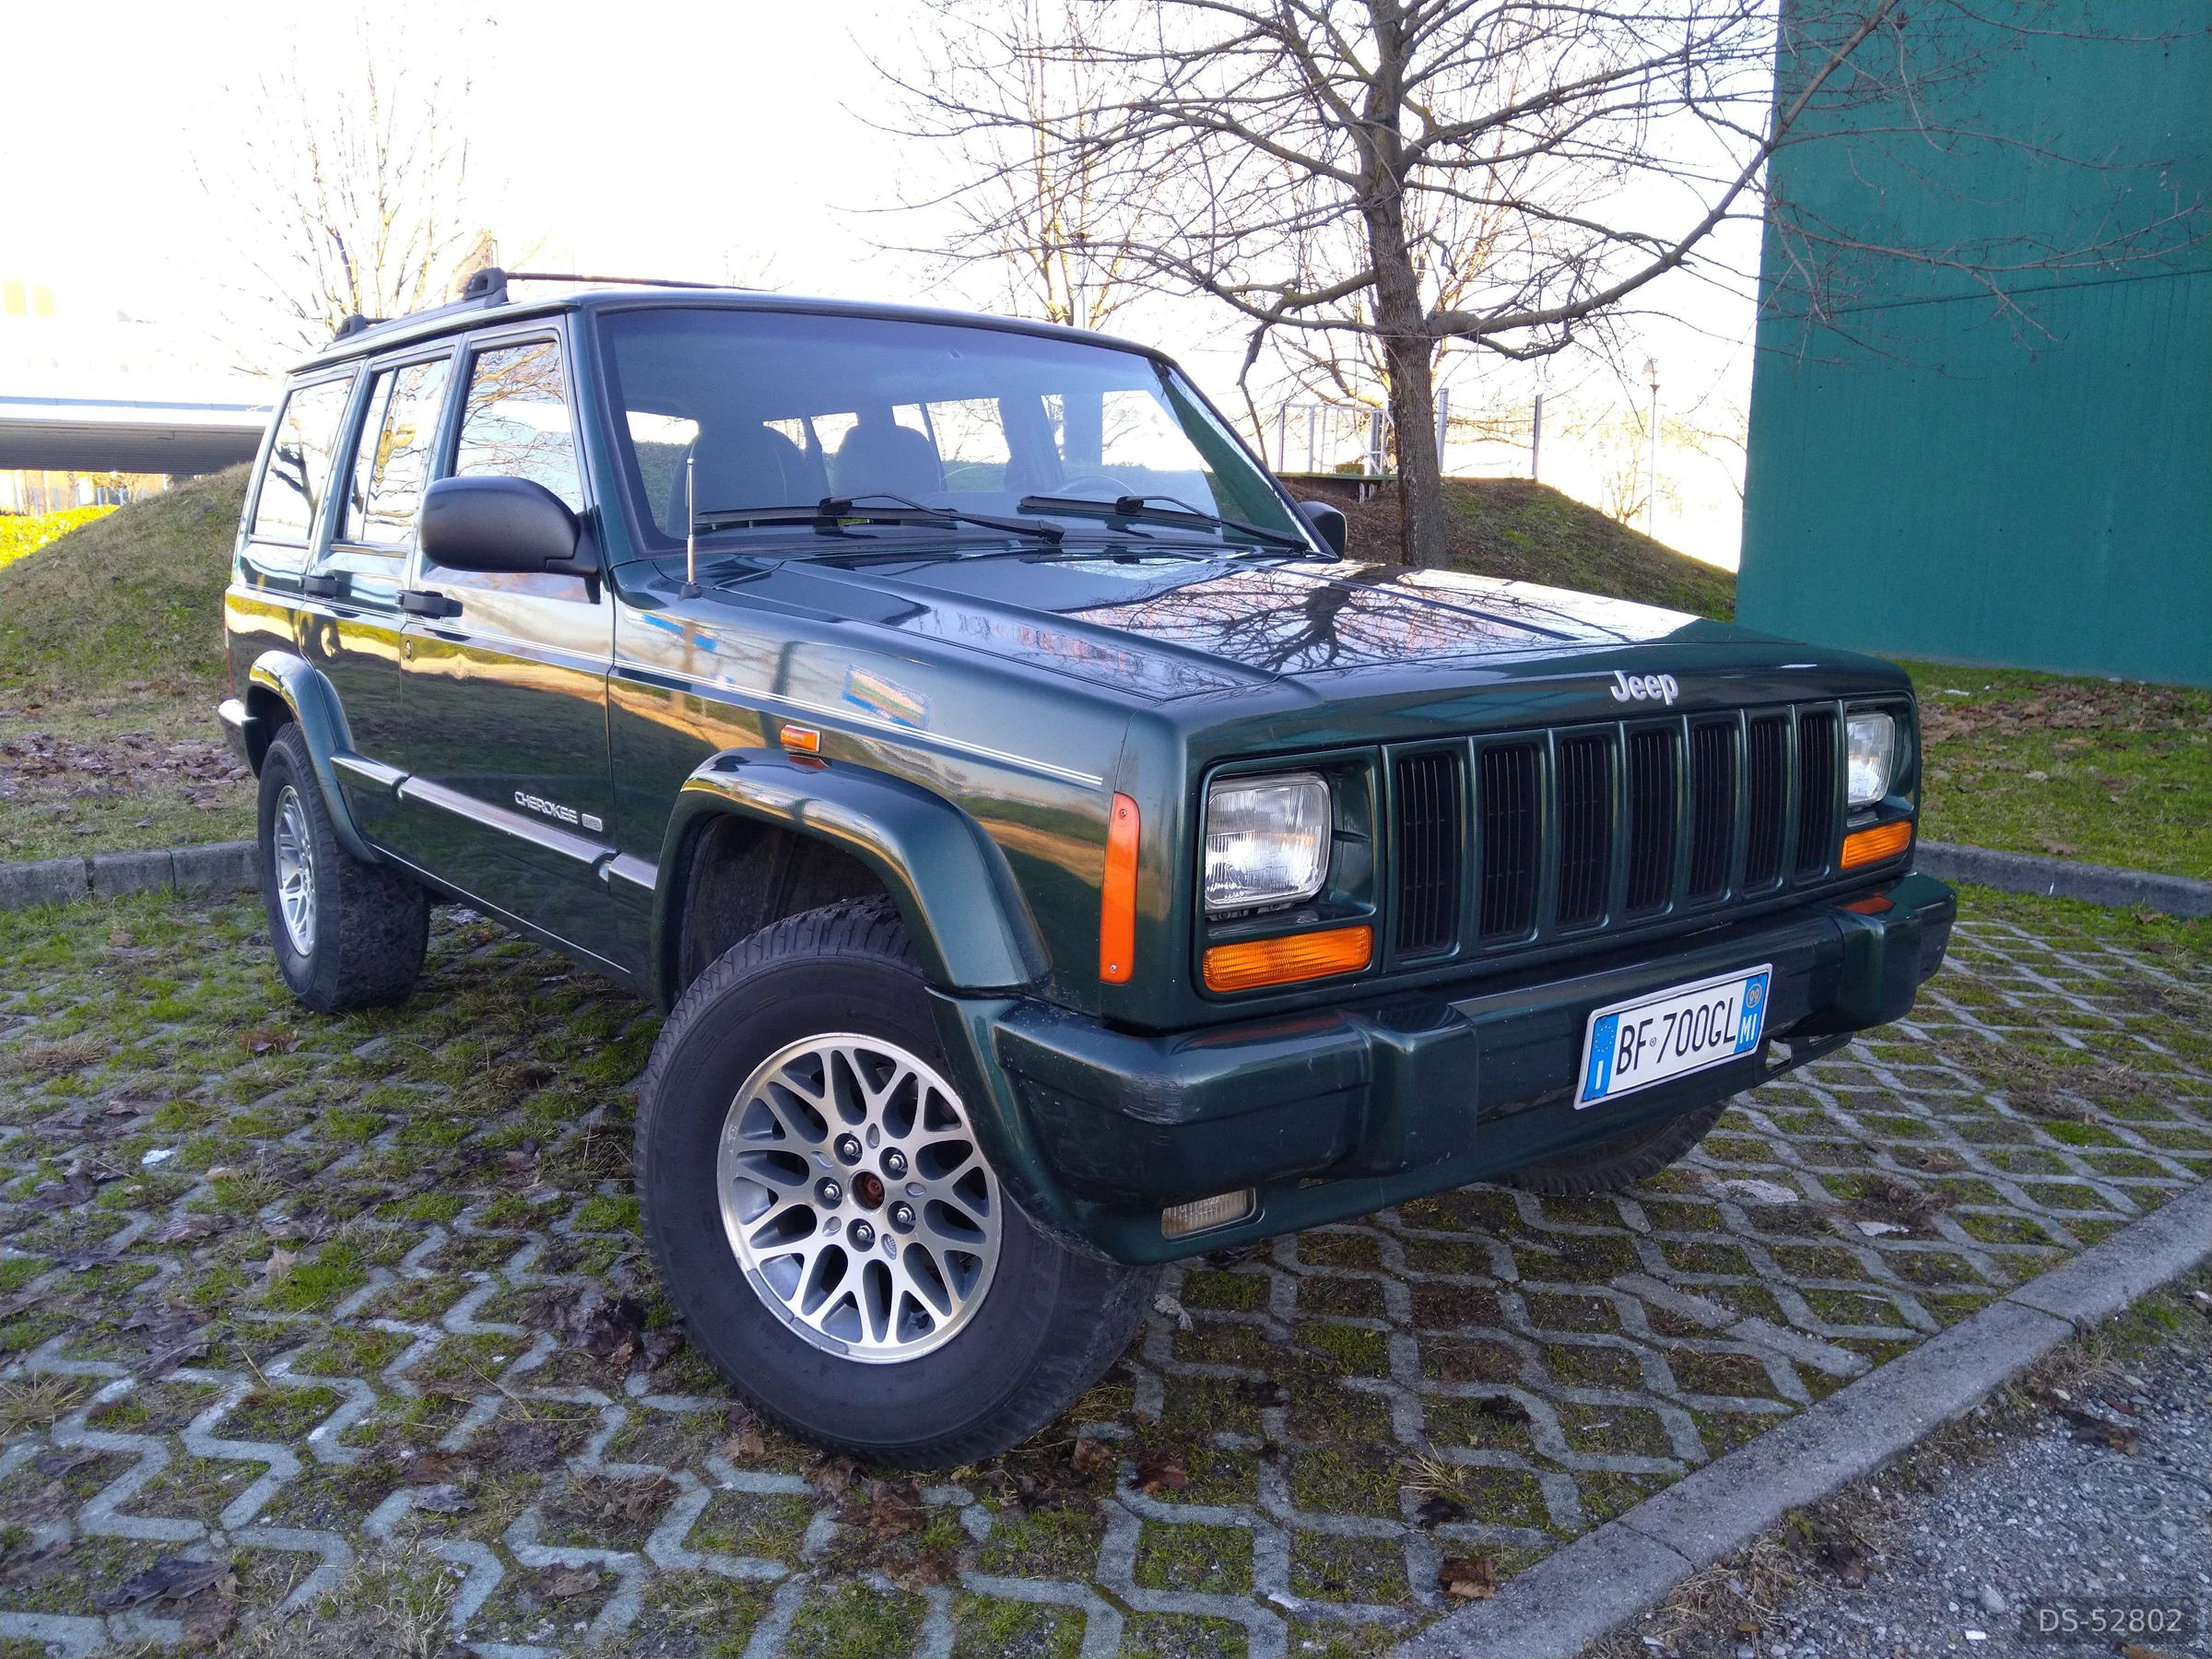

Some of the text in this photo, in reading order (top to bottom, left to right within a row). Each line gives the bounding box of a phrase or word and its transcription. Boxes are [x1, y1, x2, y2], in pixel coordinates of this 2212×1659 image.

[1609, 670, 1679, 706] Jeep
[514, 791, 578, 825] CHEROKEE
[1739, 1013, 1758, 1044] MI
[1594, 1060, 1604, 1089] I
